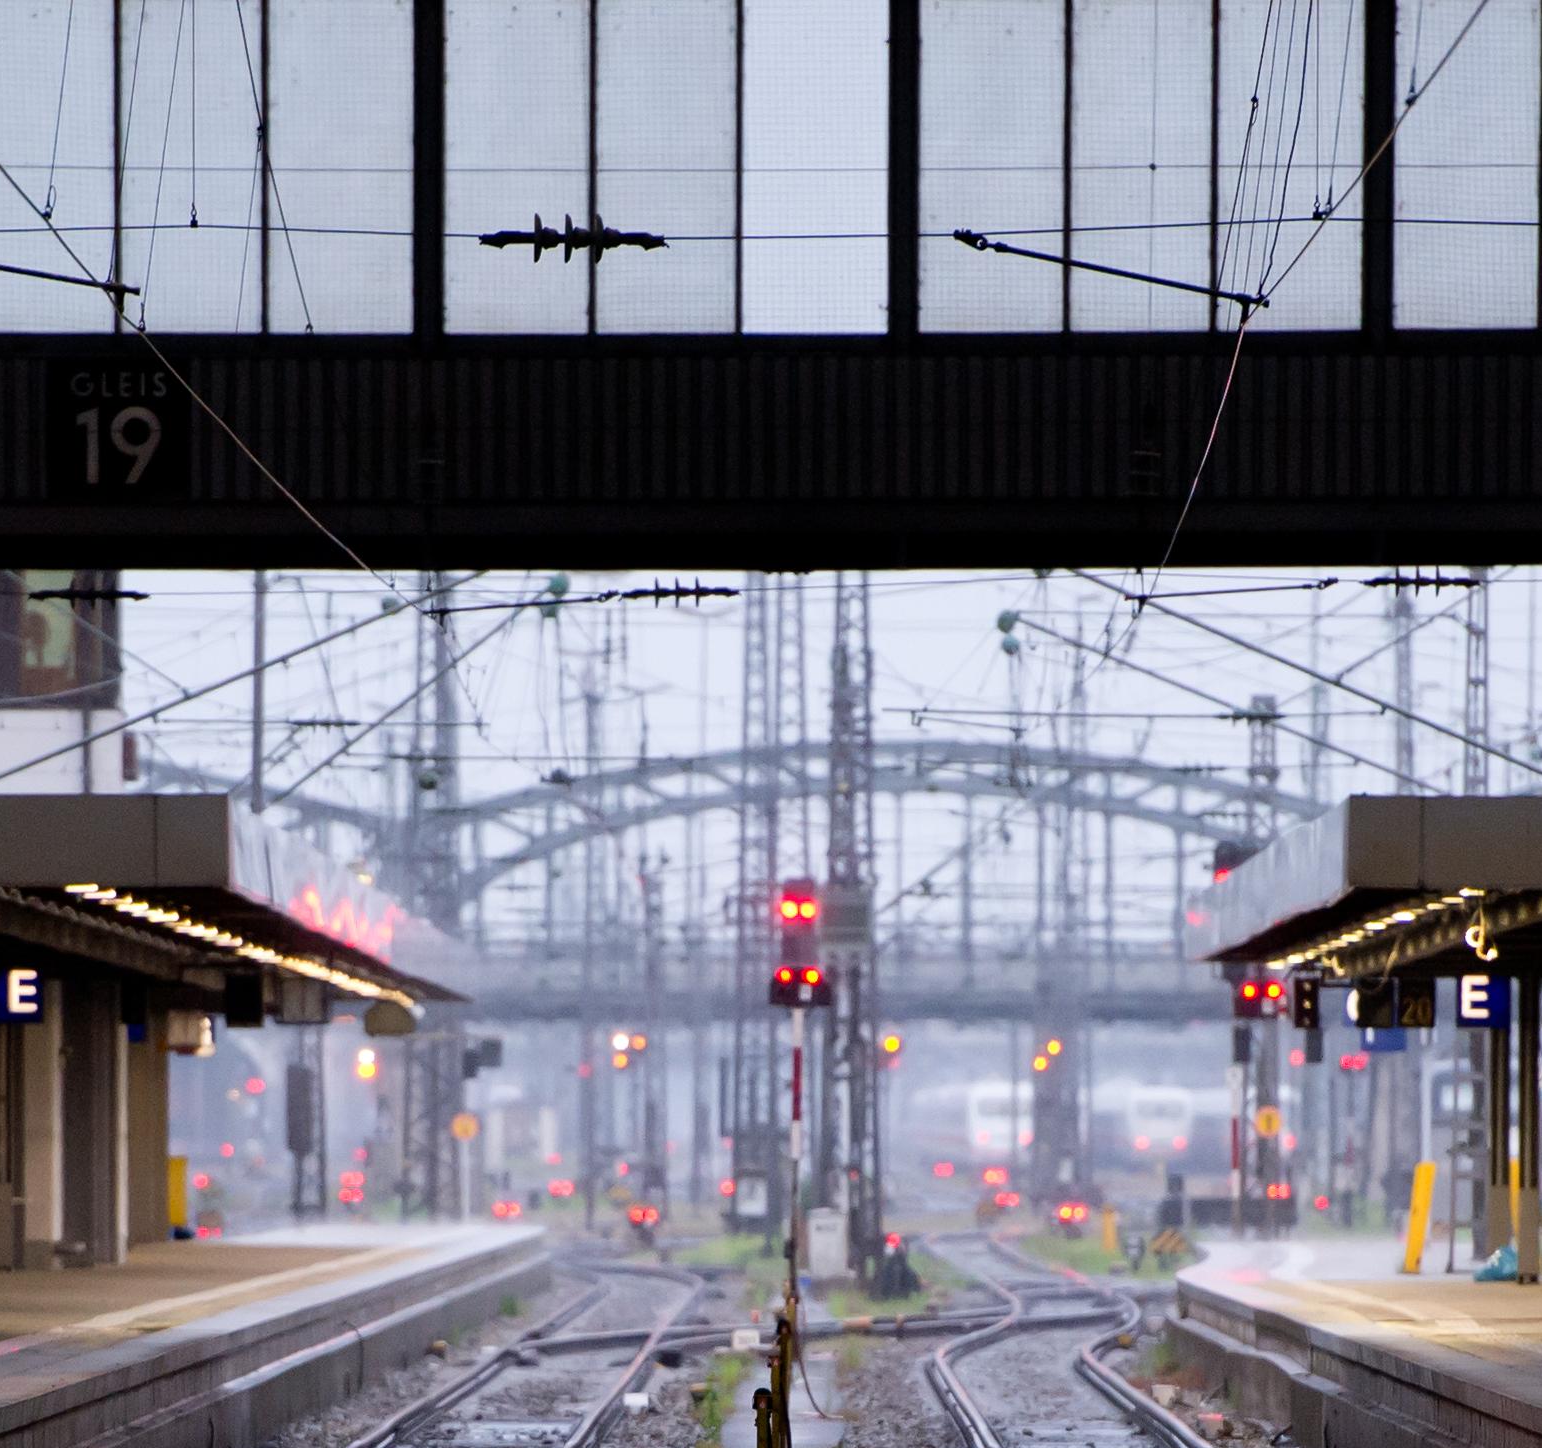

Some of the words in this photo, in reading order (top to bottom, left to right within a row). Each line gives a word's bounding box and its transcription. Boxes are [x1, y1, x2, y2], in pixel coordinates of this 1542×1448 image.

[70, 371, 168, 399] GLEIS
[75, 405, 163, 485] 19
[7, 969, 38, 1013] E
[1460, 974, 1490, 1019] E
